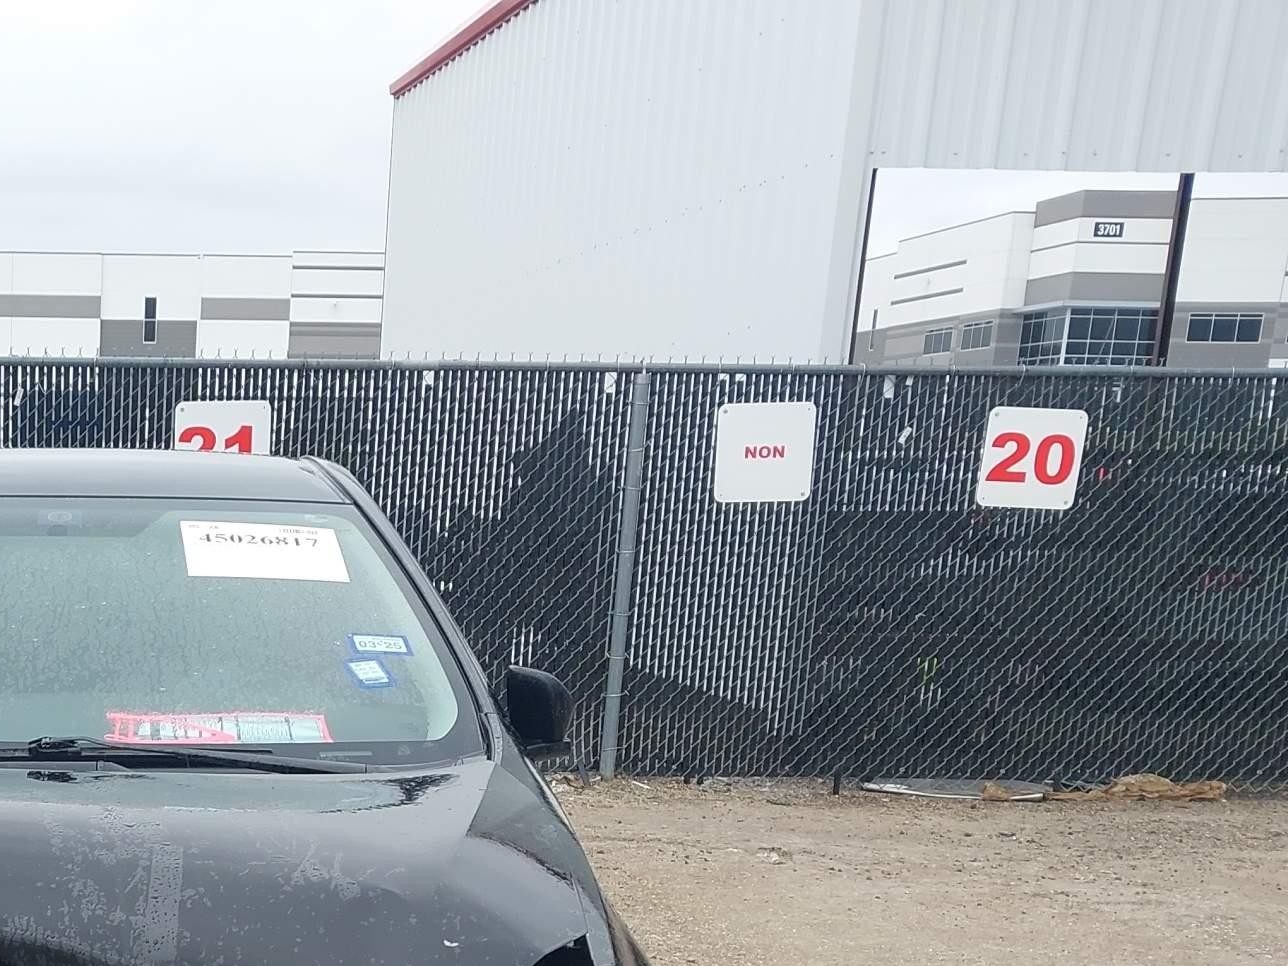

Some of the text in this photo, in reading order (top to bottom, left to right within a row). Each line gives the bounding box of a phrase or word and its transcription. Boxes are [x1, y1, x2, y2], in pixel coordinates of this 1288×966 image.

[1097, 223, 1121, 236] 3701
[744, 445, 785, 459] NON
[985, 432, 1076, 485] 20
[199, 532, 318, 548] 45026817
